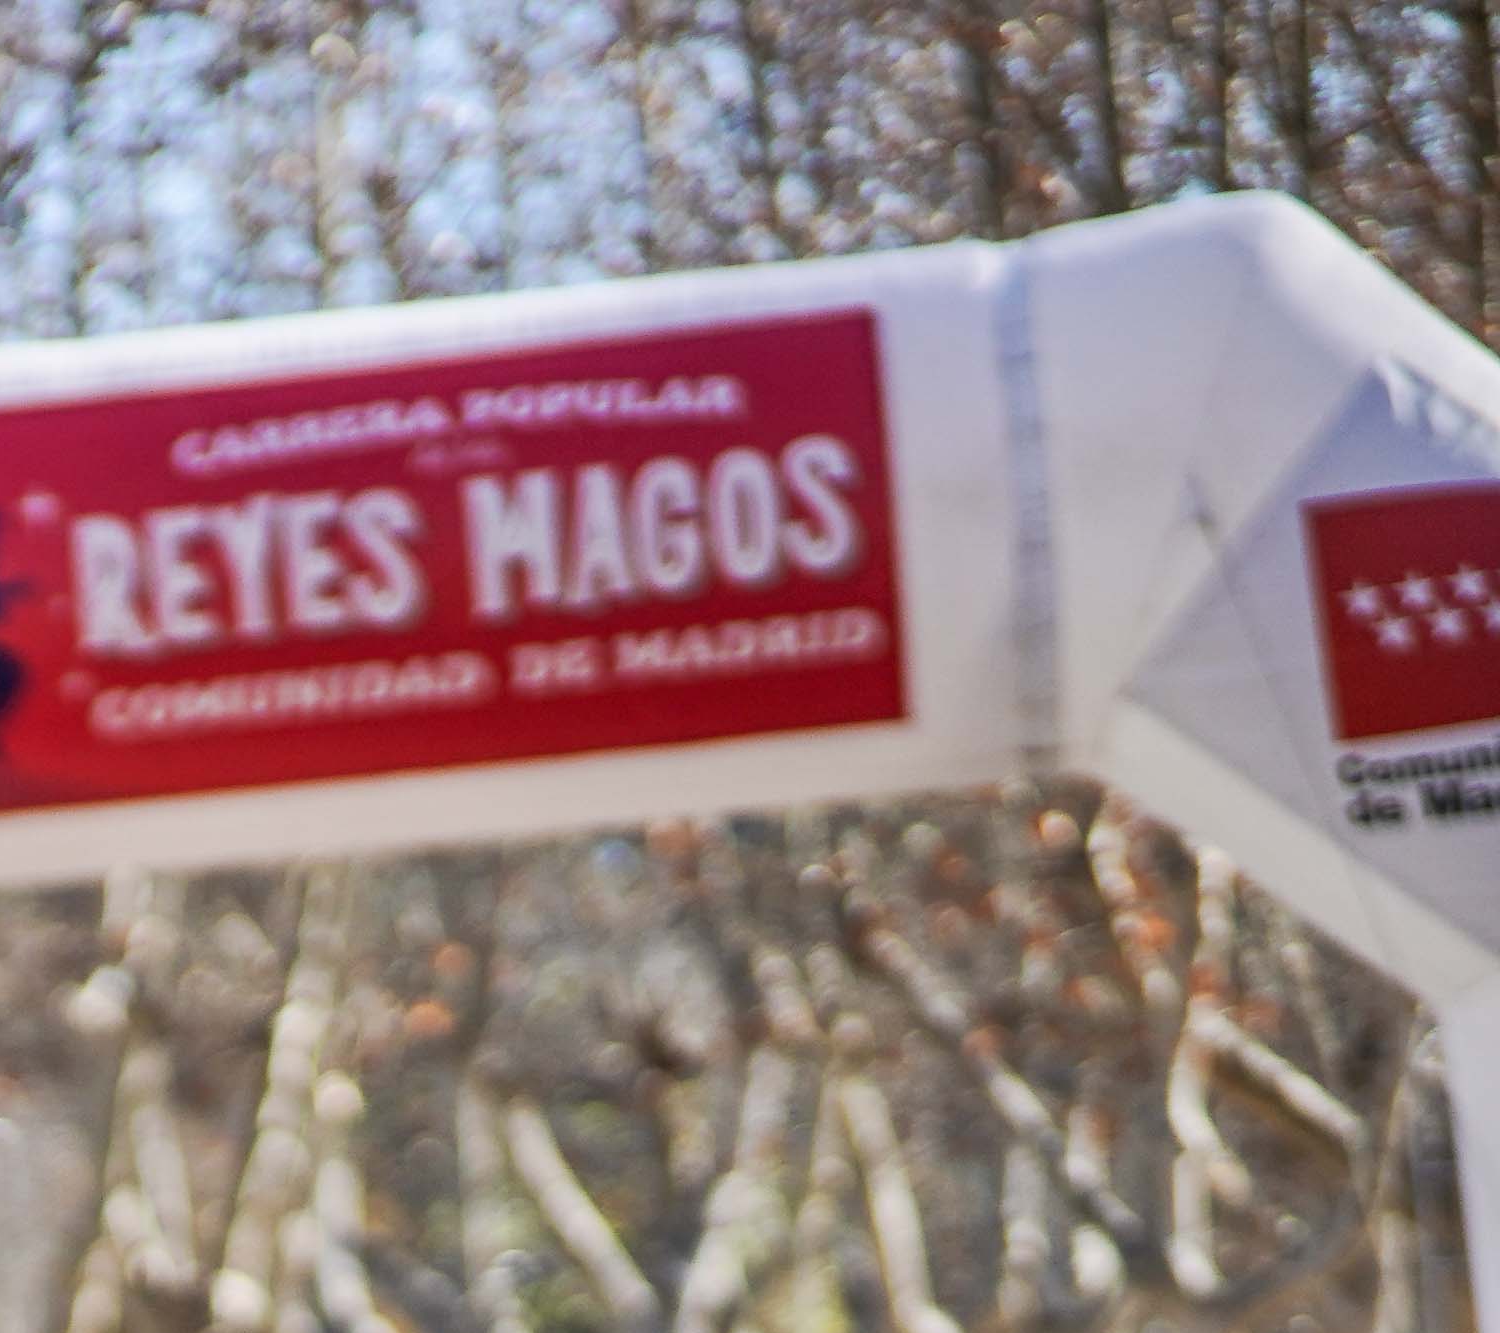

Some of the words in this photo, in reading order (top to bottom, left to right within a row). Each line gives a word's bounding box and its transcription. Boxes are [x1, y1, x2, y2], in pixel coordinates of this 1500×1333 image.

[171, 392, 452, 476] CARRERA
[460, 373, 747, 428] POPULAR
[70, 485, 425, 660] REYES
[462, 433, 861, 622] MAGOS
[89, 649, 498, 741] COMUNIDAD
[508, 636, 597, 694] DE
[611, 605, 890, 682] MADRID
